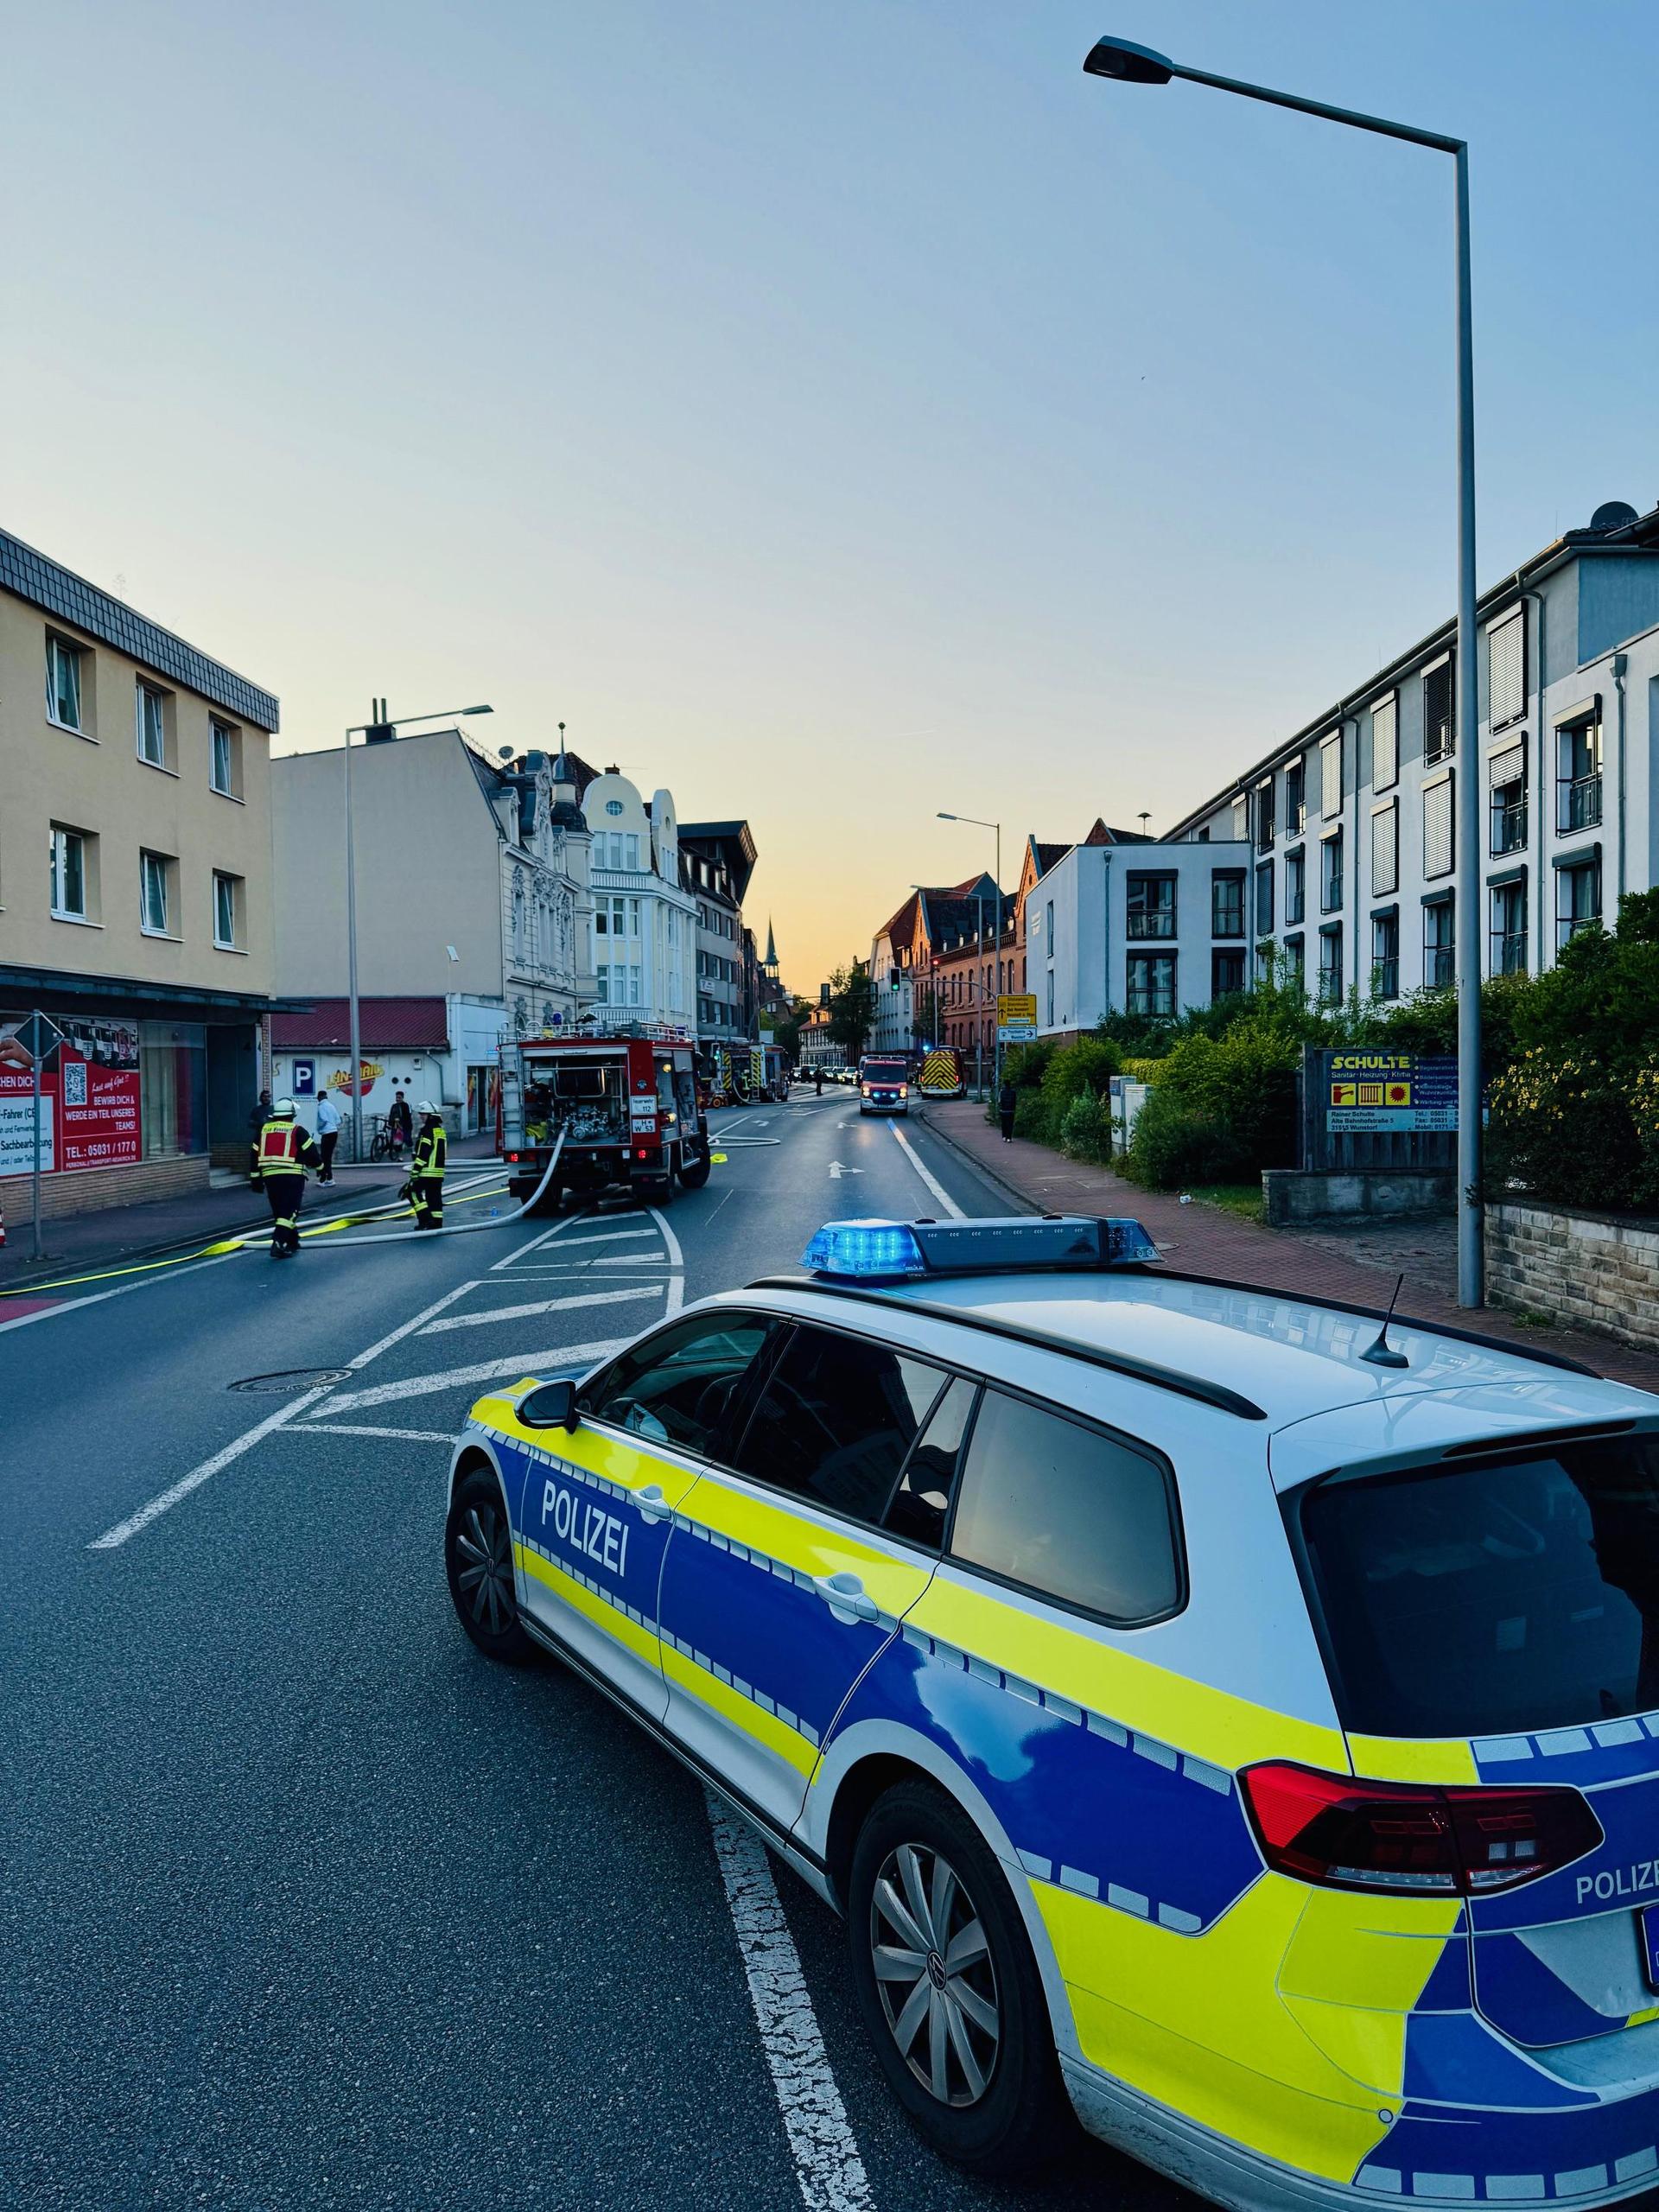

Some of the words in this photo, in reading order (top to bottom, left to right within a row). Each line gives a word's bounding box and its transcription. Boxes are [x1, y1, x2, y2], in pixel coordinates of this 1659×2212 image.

[1331, 1056, 1411, 1070] SCHULTE
[296, 1067, 311, 1088] P
[1359, 1071, 1389, 1080] Heizung
[93, 1096, 117, 1106] BEWIRB
[117, 1095, 130, 1104] DICH
[130, 1095, 136, 1104] &
[0, 1108, 23, 1120] -Fahrer
[65, 1109, 87, 1121] WERDE
[88, 1109, 99, 1120] EIN
[99, 1109, 111, 1119] TEIL
[111, 1108, 136, 1118] UNSERES
[115, 1121, 137, 1131] TEAMS!
[66, 1147, 87, 1160] TEL.:
[87, 1142, 111, 1157] 05031
[542, 1479, 629, 1577] POLIZEI
